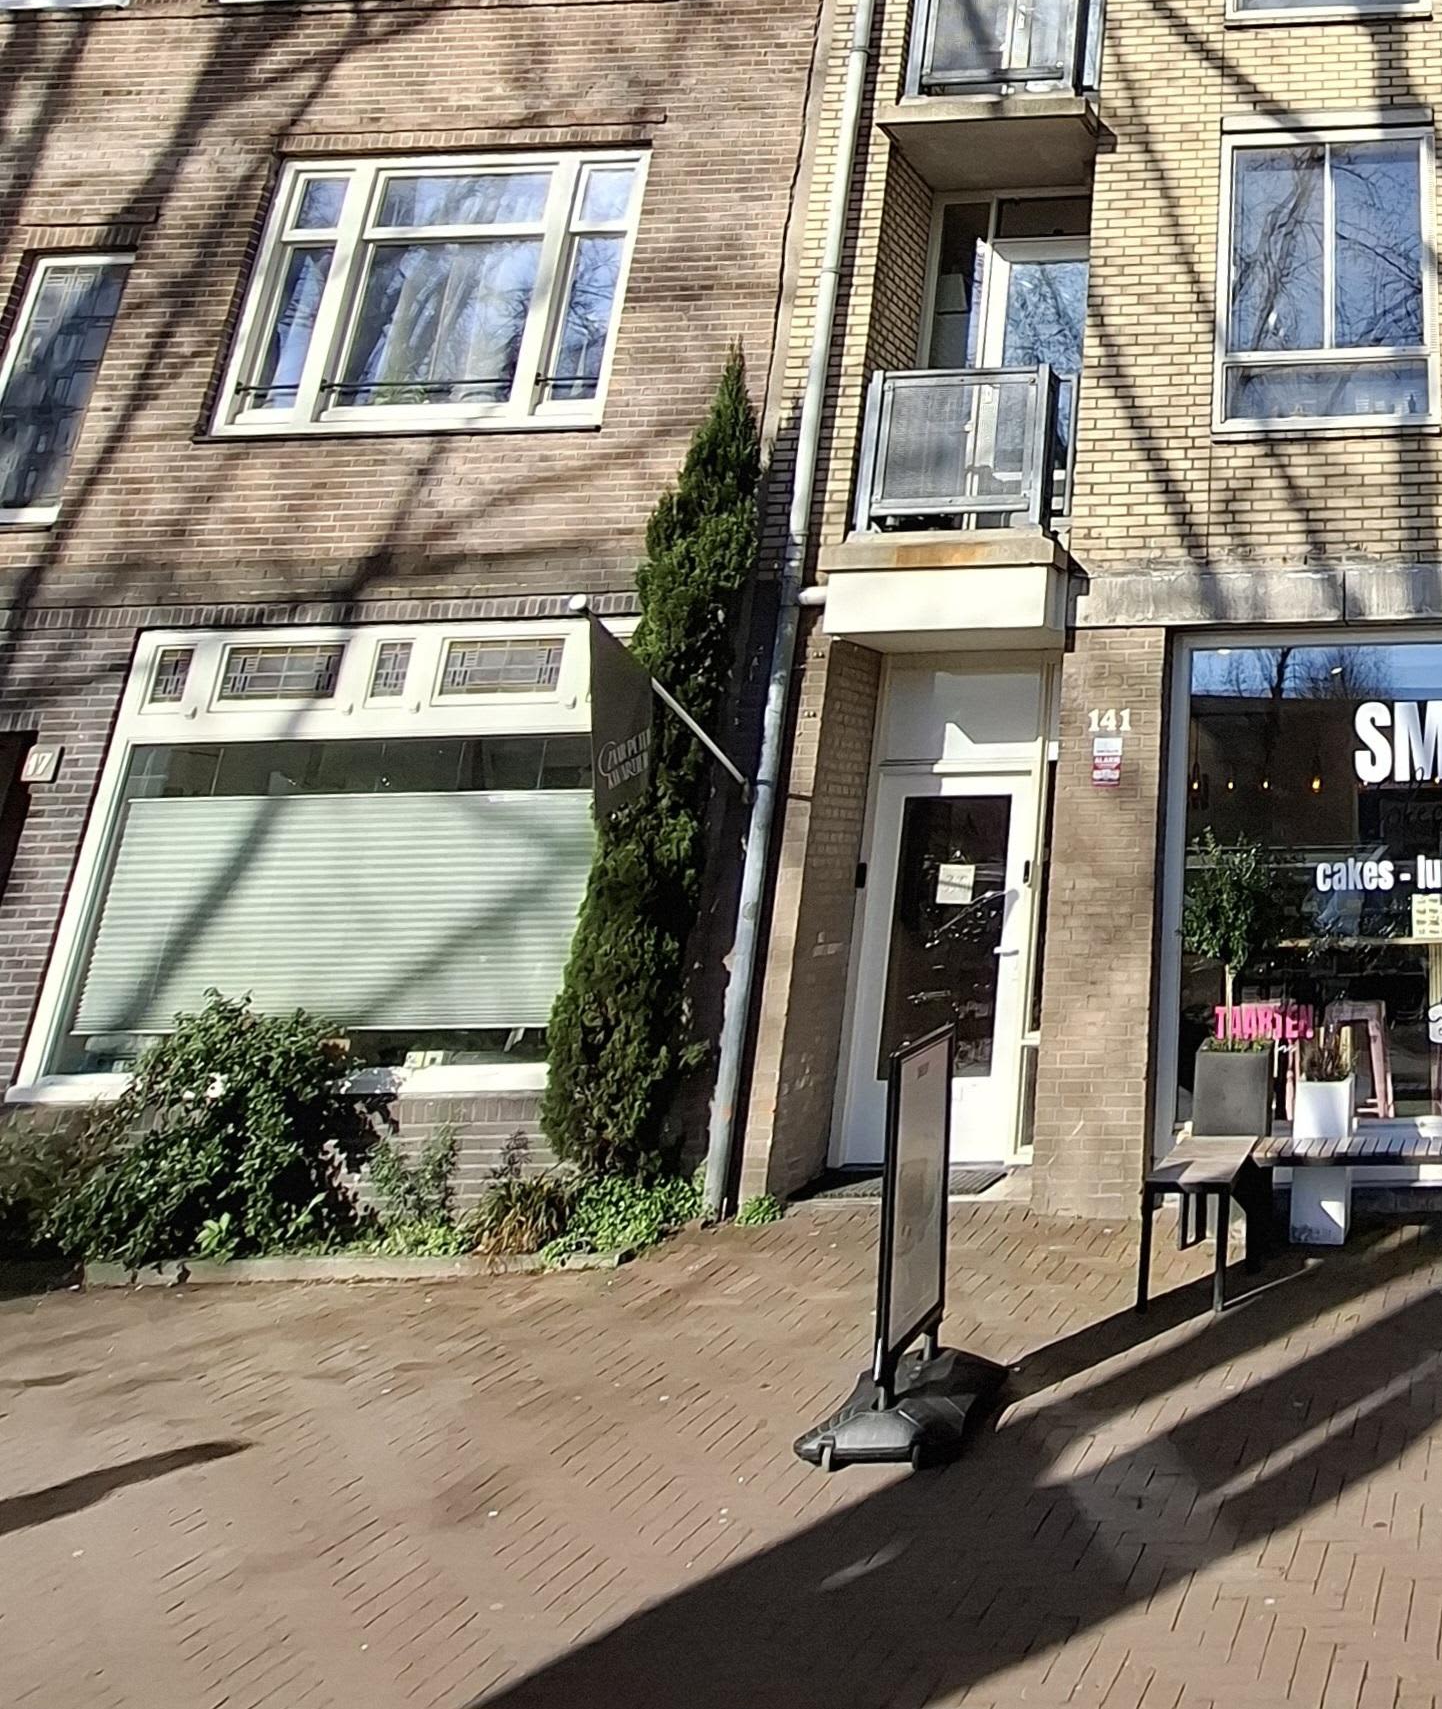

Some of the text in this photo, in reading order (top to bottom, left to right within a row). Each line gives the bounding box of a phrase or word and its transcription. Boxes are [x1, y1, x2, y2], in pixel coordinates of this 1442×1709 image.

[1088, 707, 1131, 732] 141
[26, 752, 53, 776] 17
[1316, 857, 1394, 892] cakes
